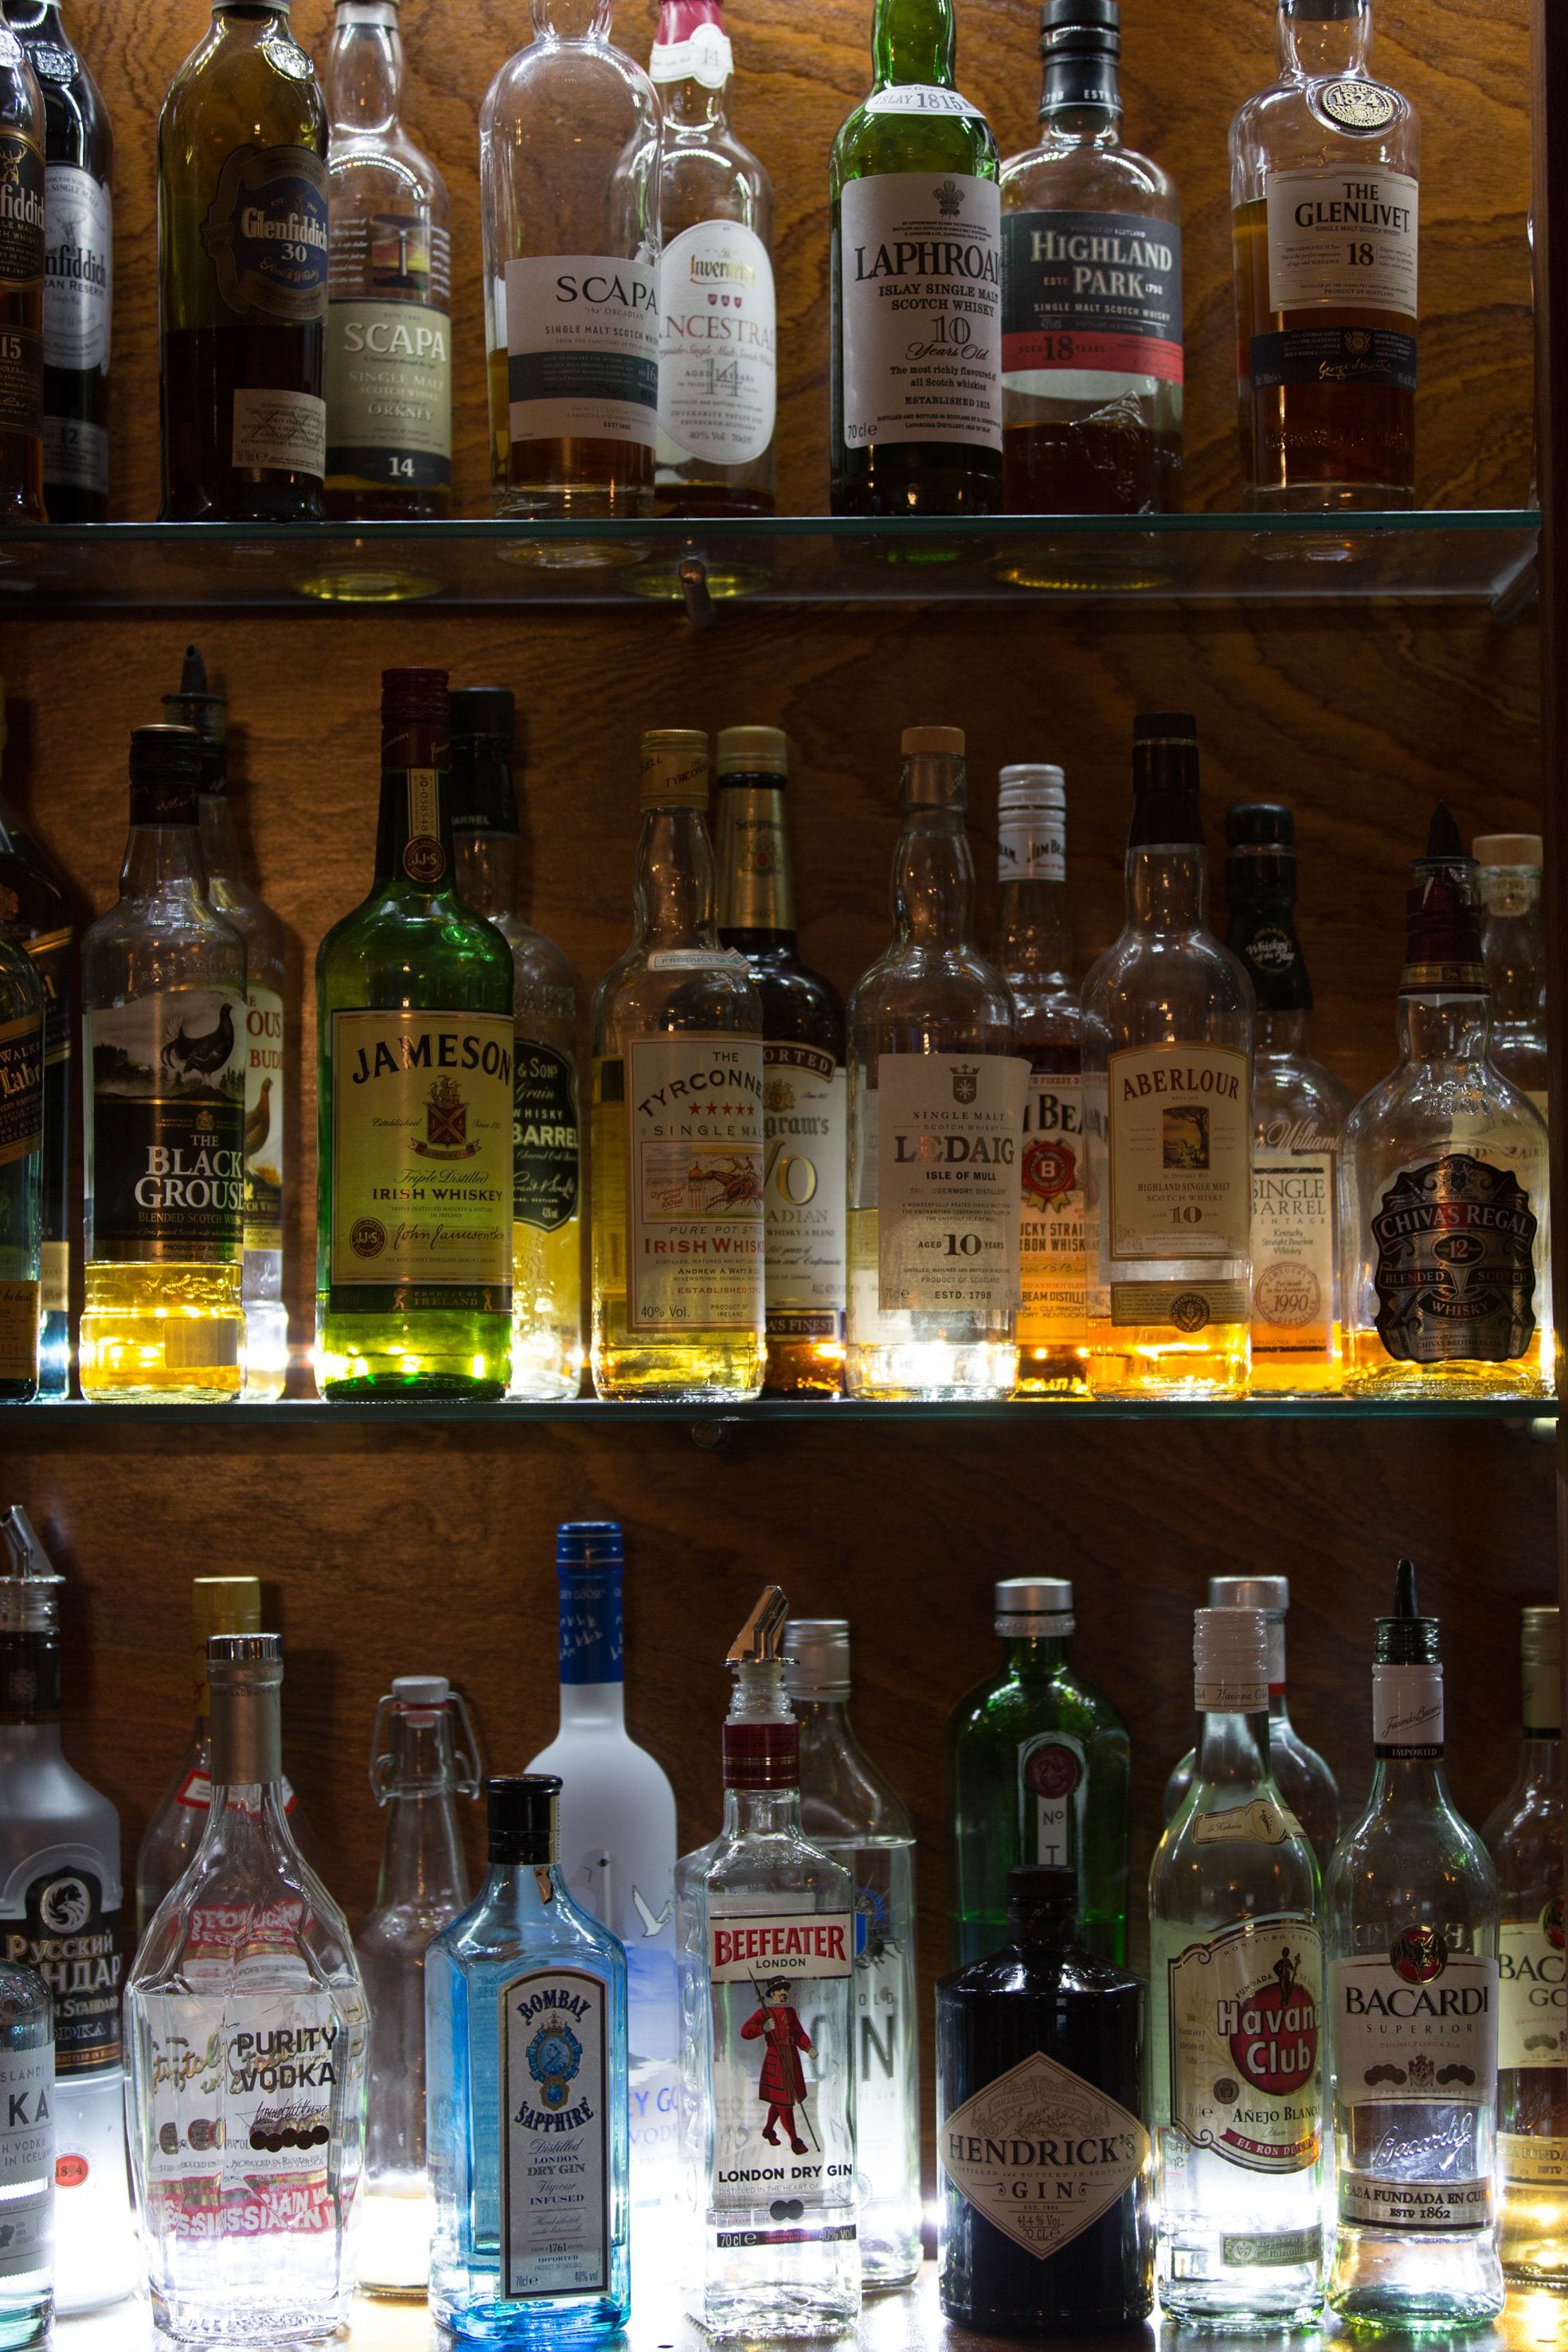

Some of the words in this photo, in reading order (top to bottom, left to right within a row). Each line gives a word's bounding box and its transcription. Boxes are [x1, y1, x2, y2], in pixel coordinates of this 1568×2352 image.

[917, 93, 964, 115] 1815
[1343, 182, 1379, 202] THE
[1294, 202, 1410, 233] GLENLIVET
[241, 206, 327, 252] Glenfiddich
[281, 243, 307, 263] 30
[1030, 230, 1173, 272] HIGHLAND
[1346, 242, 1374, 266] 18
[1073, 265, 1145, 300] PARK
[556, 275, 659, 315] SCAPA
[878, 284, 922, 297] ISLAY
[925, 284, 975, 297] SINGLE
[978, 290, 999, 303] MALT
[891, 299, 948, 311] SCOTCH
[952, 299, 995, 317] WHISKY
[1034, 303, 1069, 312] SINGLE
[1075, 303, 1100, 312] MALT
[1105, 305, 1140, 316] SCOTCH
[545, 325, 581, 335] SINGLE
[585, 326, 610, 335] MALT
[613, 328, 643, 339] SCOTCH
[931, 315, 971, 345] 10
[1, 337, 22, 359] 15
[343, 322, 447, 362] SCAPA
[1044, 335, 1074, 362] 18
[905, 342, 959, 361] Years
[961, 344, 989, 360] Old
[890, 366, 908, 375] The
[909, 366, 931, 375] most
[933, 366, 959, 376] richly
[960, 367, 991, 380] flavoured
[925, 378, 954, 387] Scotch
[956, 381, 986, 391] whiskies
[904, 397, 974, 407] ESTABLISHED
[976, 401, 991, 409] 1815
[61, 429, 78, 444] 12
[389, 456, 415, 478] 14
[351, 1034, 512, 1086] JAMESON
[713, 1051, 739, 1063] THE
[1122, 1068, 1240, 1103] ABERLOUR
[913, 1111, 970, 1121] SINGLE
[974, 1112, 1005, 1122] MALT
[653, 1125, 736, 1137] SINGLE
[190, 1135, 219, 1147] THE
[893, 1135, 1015, 1165] LEDAIG
[146, 1145, 242, 1178] BLACK
[393, 1168, 438, 1189] Triple
[439, 1168, 490, 1185] Distilled
[925, 1171, 955, 1180] ISLE
[956, 1171, 970, 1180] OF
[973, 1172, 997, 1181] MULL
[372, 1188, 425, 1200] IRISH
[431, 1188, 503, 1202] WHISKEY
[1138, 1182, 1180, 1192] HIGHLAND
[1181, 1182, 1210, 1192] SINGLE
[1211, 1182, 1230, 1192] MALT
[1146, 1194, 1186, 1203] SCOTCH
[1189, 1194, 1224, 1203] WHISKY
[139, 1211, 185, 1223] BLENDED
[187, 1213, 221, 1223] SCOTCH
[768, 1209, 828, 1224] ADIAN
[1169, 1205, 1202, 1226] 10
[1381, 1205, 1461, 1239] CHIVAS
[1466, 1204, 1529, 1238] REGAL
[670, 1226, 708, 1235] PURE
[644, 1239, 707, 1254] IRISH
[943, 1234, 982, 1256] 10
[1449, 1239, 1468, 1259] 12
[1386, 1272, 1445, 1284] BLENDED
[1478, 1272, 1527, 1283] SCOTCH
[1022, 1291, 1047, 1301] BEAM
[1274, 1294, 1309, 1313] 1990
[641, 1306, 664, 1318] 40%
[669, 1305, 689, 1317] Vol.
[1432, 1300, 1488, 1316] WHISKY
[789, 1321, 833, 1331] FINEST
[713, 1924, 847, 1968] BEEFEATER
[755, 1957, 806, 1970] LONDON
[1235, 1974, 1273, 2000] FUNDADA
[515, 1989, 592, 2026] BOMBAY
[1345, 1986, 1489, 2017] BACARDI
[1218, 2000, 1322, 2036] Havana
[1366, 2023, 1473, 2034] SUPERIOR
[237, 2026, 338, 2057] PURITY
[1246, 2038, 1311, 2074] Club
[240, 2061, 338, 2092] VODKA
[9, 2088, 49, 2127] KA
[513, 2096, 596, 2134] SAPPHIRE
[1233, 2106, 1280, 2124] AÑEJO
[528, 2138, 585, 2154] Distilled
[949, 2133, 1136, 2167] HENDRICK'S
[1237, 2139, 1251, 2150] EL
[1257, 2144, 1278, 2155] RON
[534, 2155, 578, 2164] LONDON
[527, 2166, 556, 2177] DRY
[558, 2163, 585, 2174] GIN
[718, 2168, 784, 2182] LONDON
[792, 2166, 823, 2179] DRY
[827, 2164, 852, 2176] GIN
[1011, 2181, 1073, 2199] GIN
[1374, 2190, 1443, 2205] FUNDADA
[1448, 2191, 1464, 2202] EN
[530, 2194, 585, 2205] INFUSED
[1420, 2206, 1451, 2218] 1862
[549, 2243, 568, 2252] 1761
